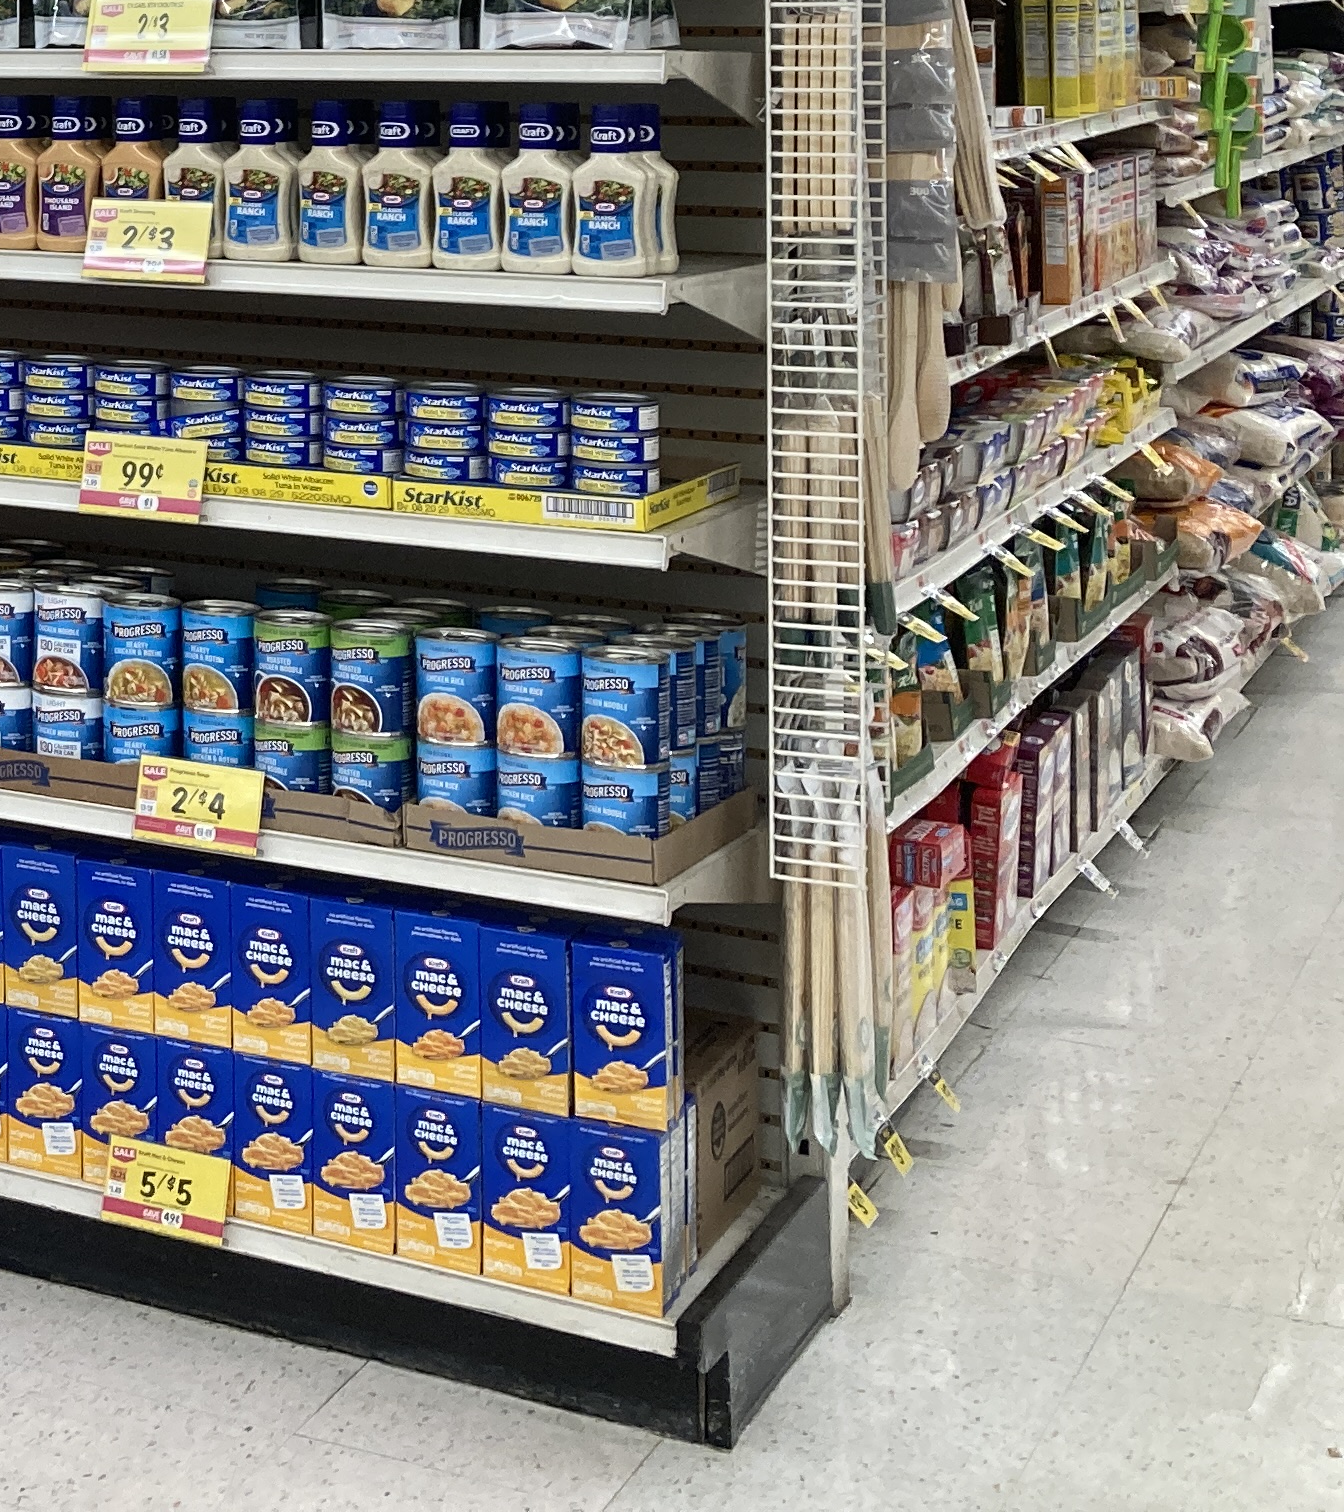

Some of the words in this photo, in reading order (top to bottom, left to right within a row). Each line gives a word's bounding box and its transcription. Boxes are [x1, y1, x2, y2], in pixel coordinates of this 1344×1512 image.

[593, 129, 618, 141] Kraft
[95, 209, 117, 217] SALE
[122, 226, 174, 250] 2/$3
[122, 461, 164, 487] 99¢
[404, 488, 482, 507] StarKist
[143, 766, 167, 775] SALE
[172, 787, 226, 820] 2/$4
[439, 830, 516, 847] PROGRESSO
[501, 988, 531, 1000] mac
[534, 992, 544, 1004] &
[596, 999, 628, 1013] mac
[631, 1003, 641, 1015] &
[113, 1147, 136, 1159] SALE
[140, 1170, 193, 1206] 5/$5
